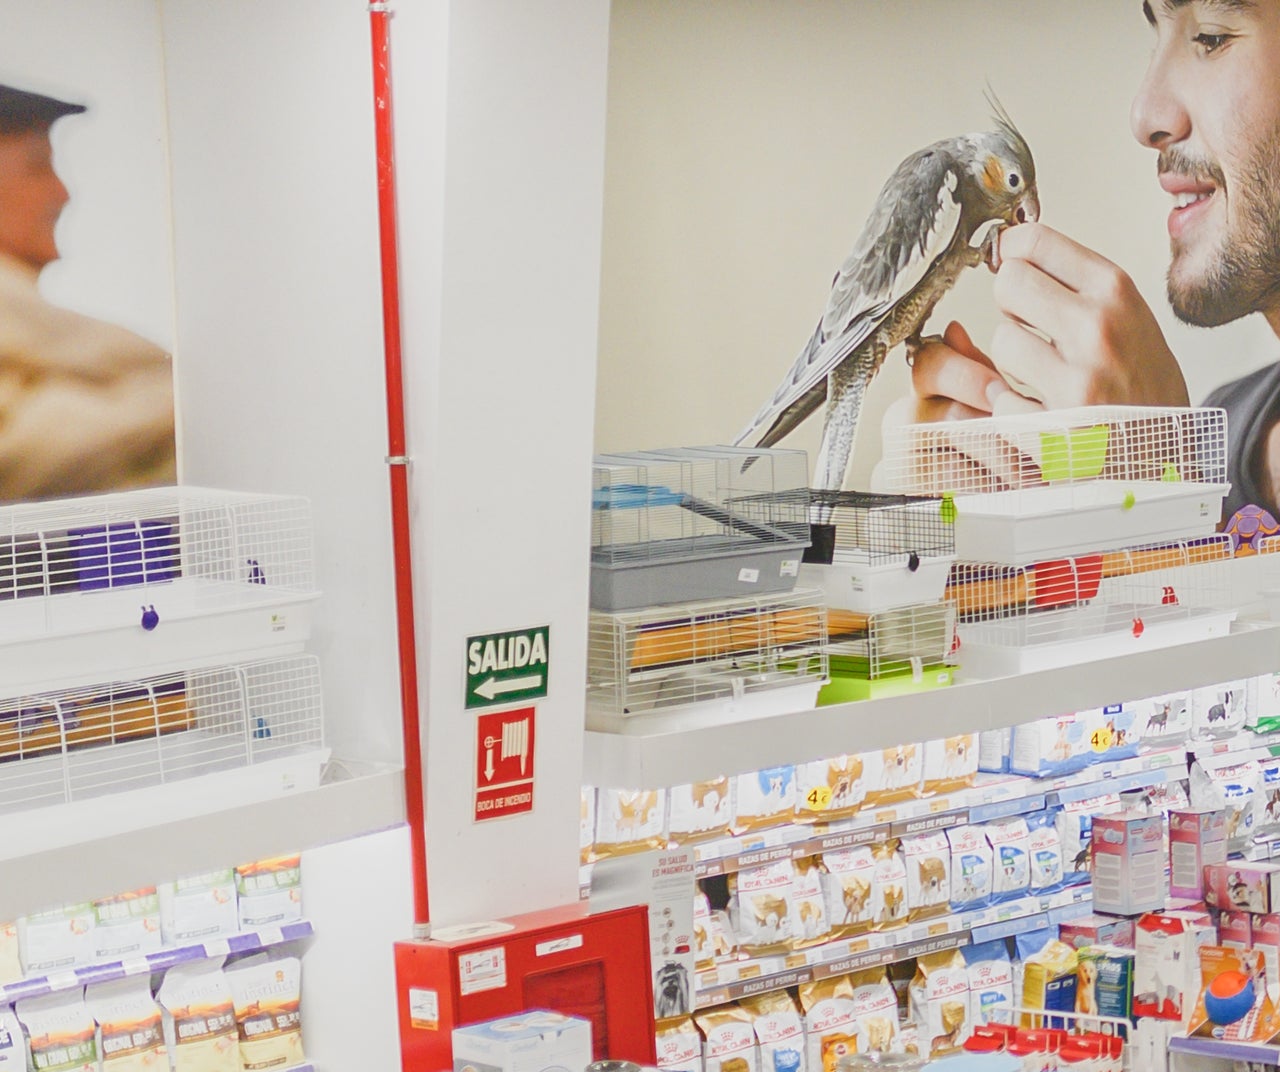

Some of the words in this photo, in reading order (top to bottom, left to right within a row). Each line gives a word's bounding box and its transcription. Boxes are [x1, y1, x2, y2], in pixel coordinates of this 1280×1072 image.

[468, 633, 547, 675] SALIDA
[1091, 732, 1099, 746] 4
[477, 799, 495, 812] BOCA
[495, 798, 504, 809] DE
[504, 792, 532, 807] INCENDIO
[807, 790, 818, 805] 4
